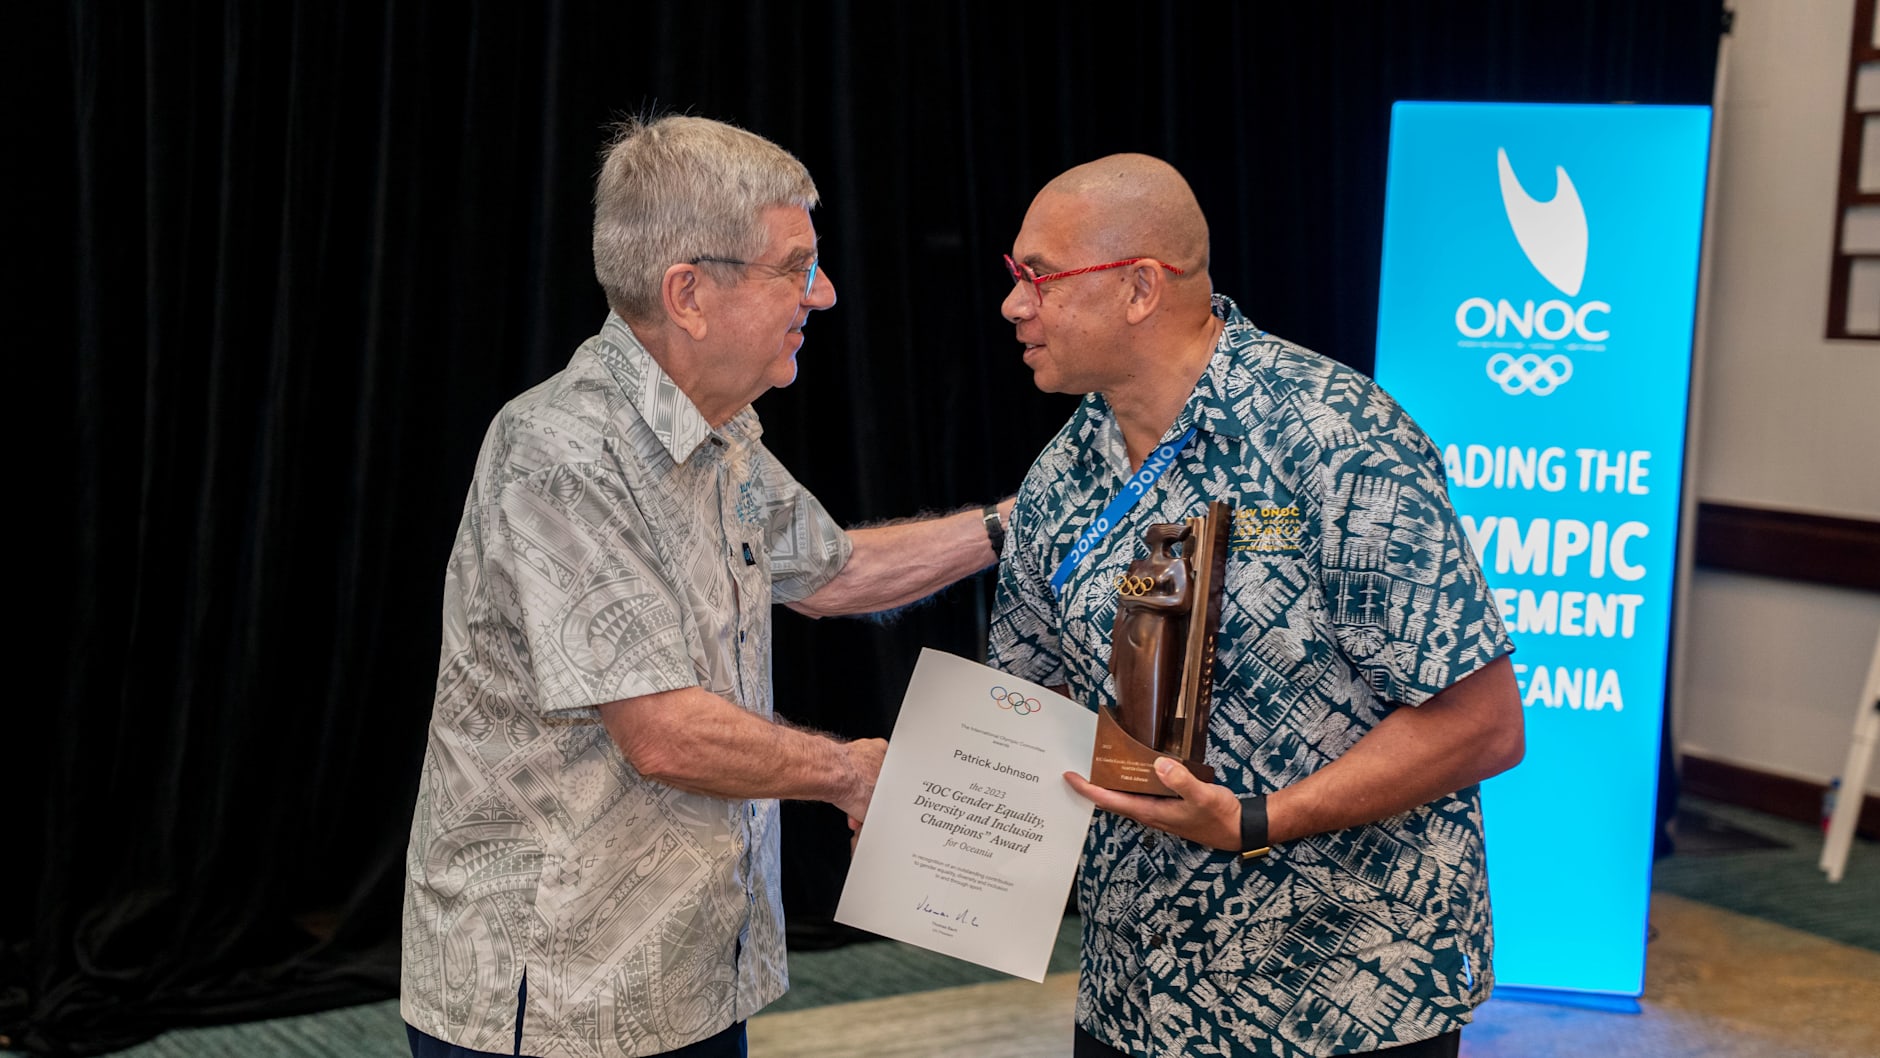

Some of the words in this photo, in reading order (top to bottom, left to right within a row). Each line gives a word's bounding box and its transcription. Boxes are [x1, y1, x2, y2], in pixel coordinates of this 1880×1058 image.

[1455, 297, 1611, 342] ONOC
[1129, 445, 1175, 496] ONOC
[1444, 443, 1568, 492] ADING
[1576, 448, 1651, 495] THE
[1233, 526, 1300, 537] ASSEMBLY
[1261, 507, 1300, 517] ONOC
[1070, 517, 1109, 563] ONOC
[1460, 515, 1650, 581] YMPIC
[1490, 588, 1645, 639] EMENT
[953, 749, 991, 769] Patrick
[992, 762, 1040, 783] Johnson
[952, 790, 994, 810] Gender
[994, 803, 1045, 829] Equality,
[968, 782, 983, 793] the
[983, 787, 1007, 799] 2023
[914, 795, 966, 820] Diversity
[966, 812, 991, 826] and
[991, 818, 1044, 842] Inclusion
[942, 838, 959, 848] for
[959, 841, 994, 858] Oceania
[990, 834, 1031, 854] Award
